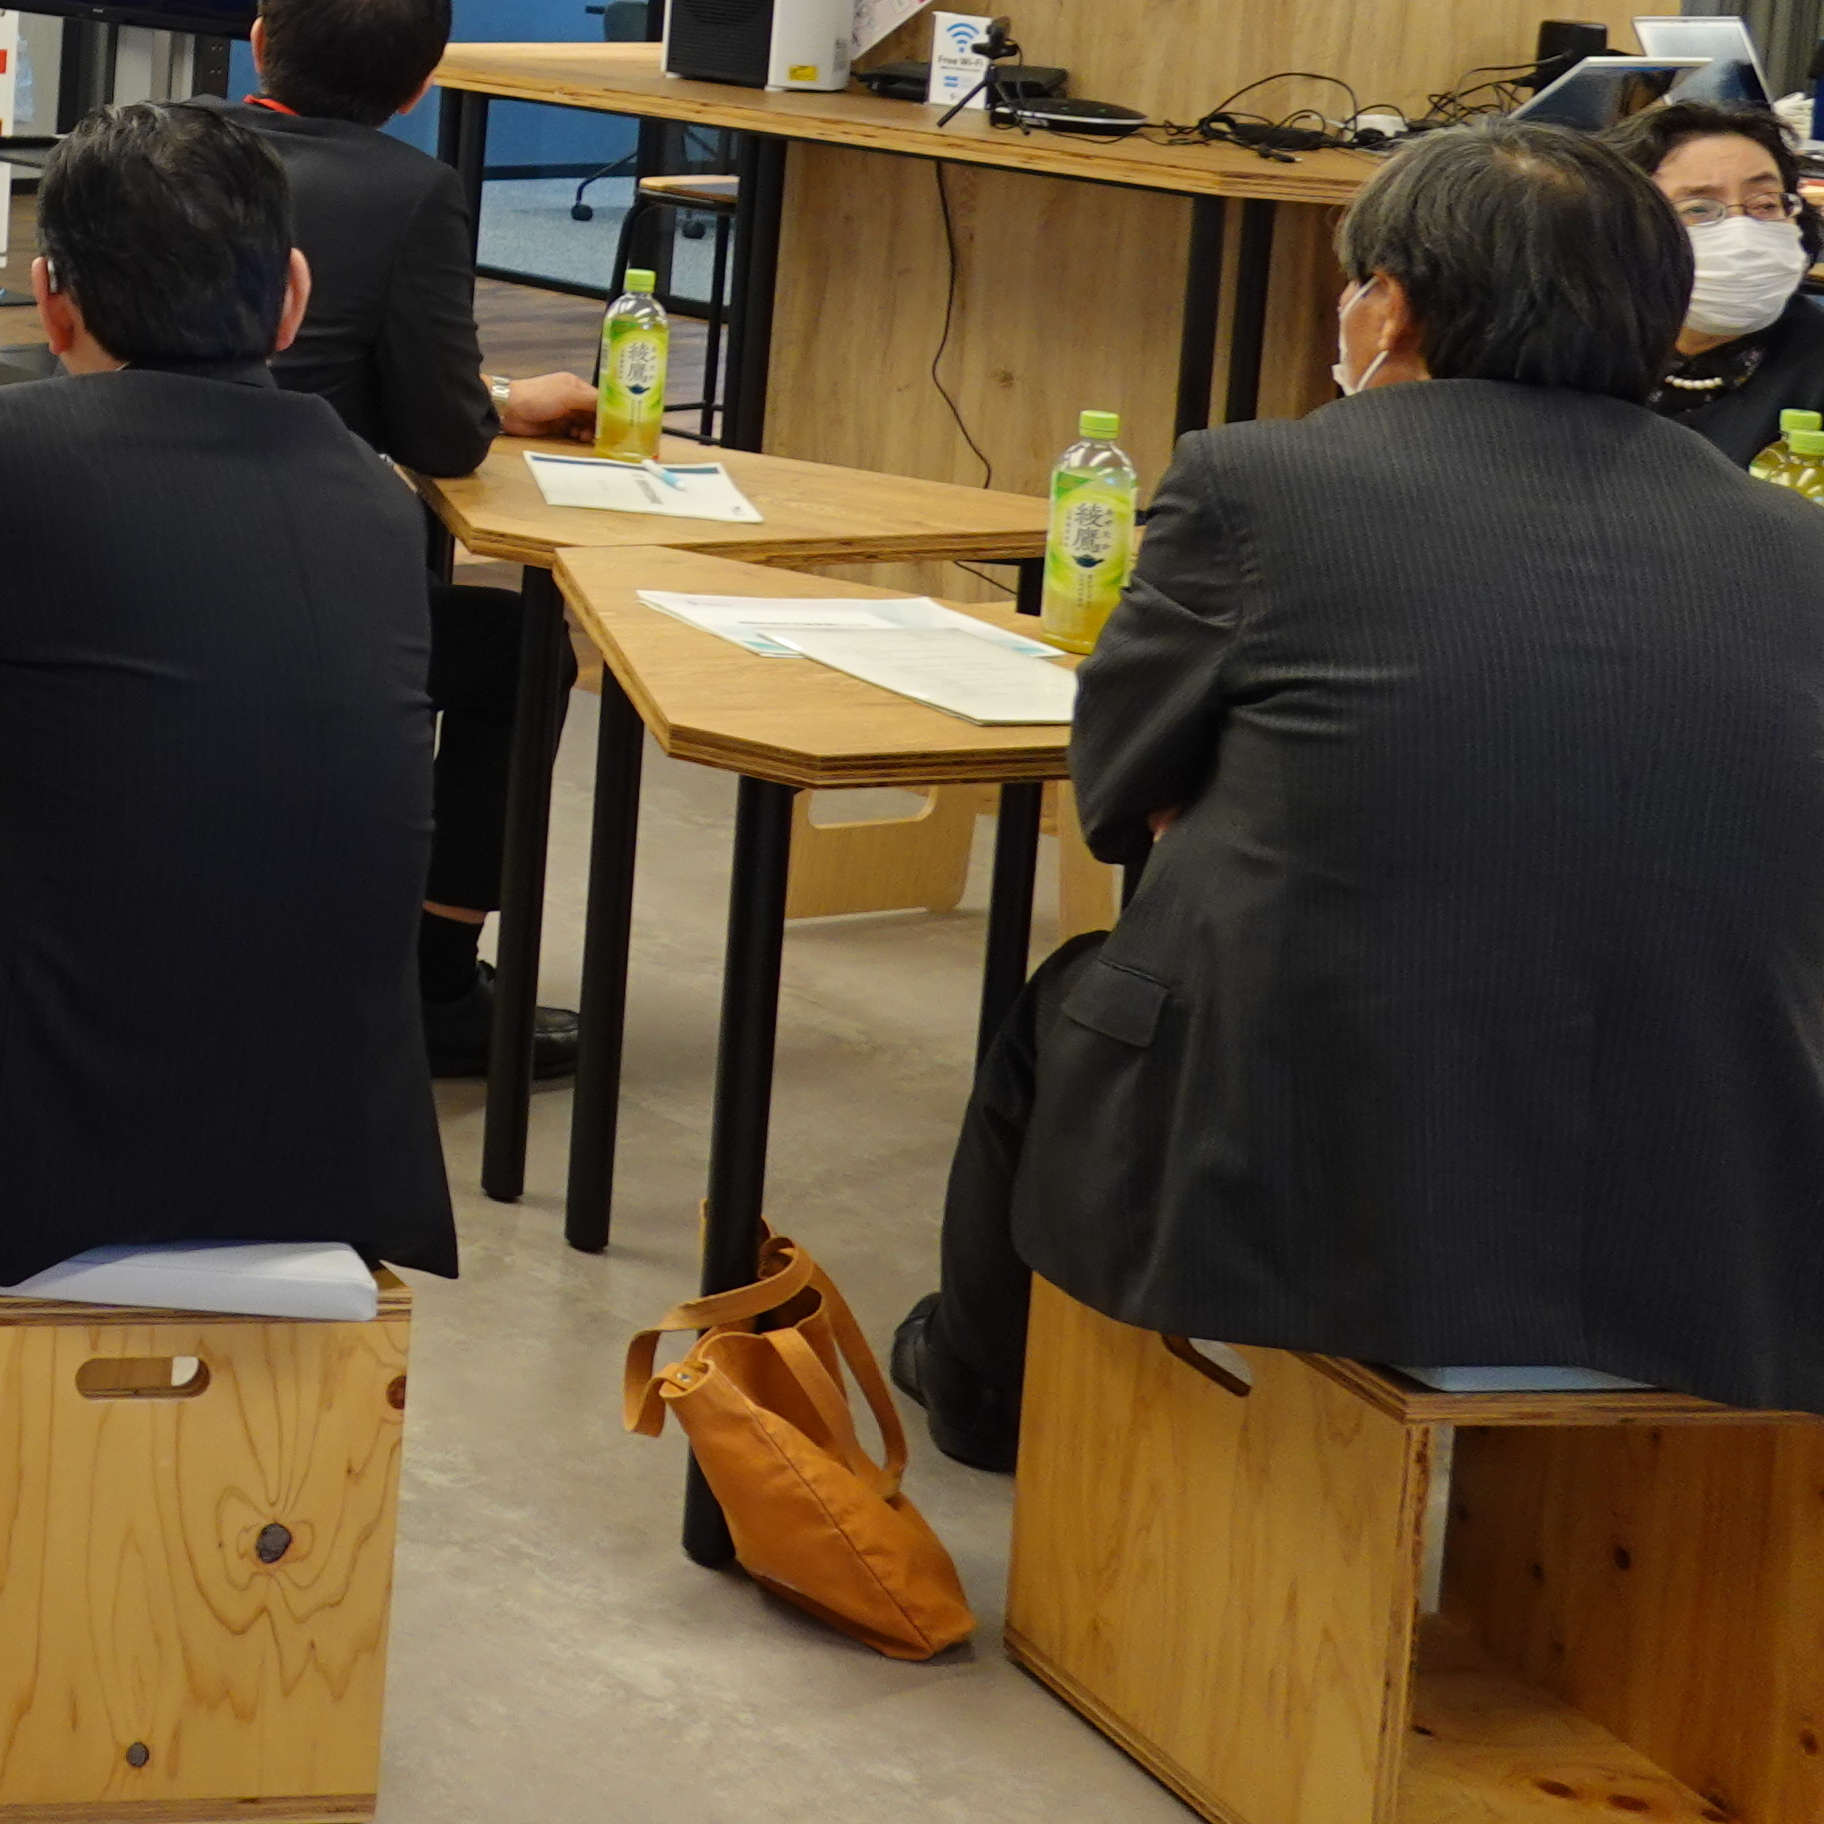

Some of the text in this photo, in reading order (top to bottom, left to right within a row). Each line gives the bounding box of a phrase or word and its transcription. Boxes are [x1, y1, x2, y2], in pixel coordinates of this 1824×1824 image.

[938, 54, 985, 68] Free Wi-Fi
[627, 342, 650, 383] 綾鷹
[1074, 502, 1103, 554] 綾鷹
